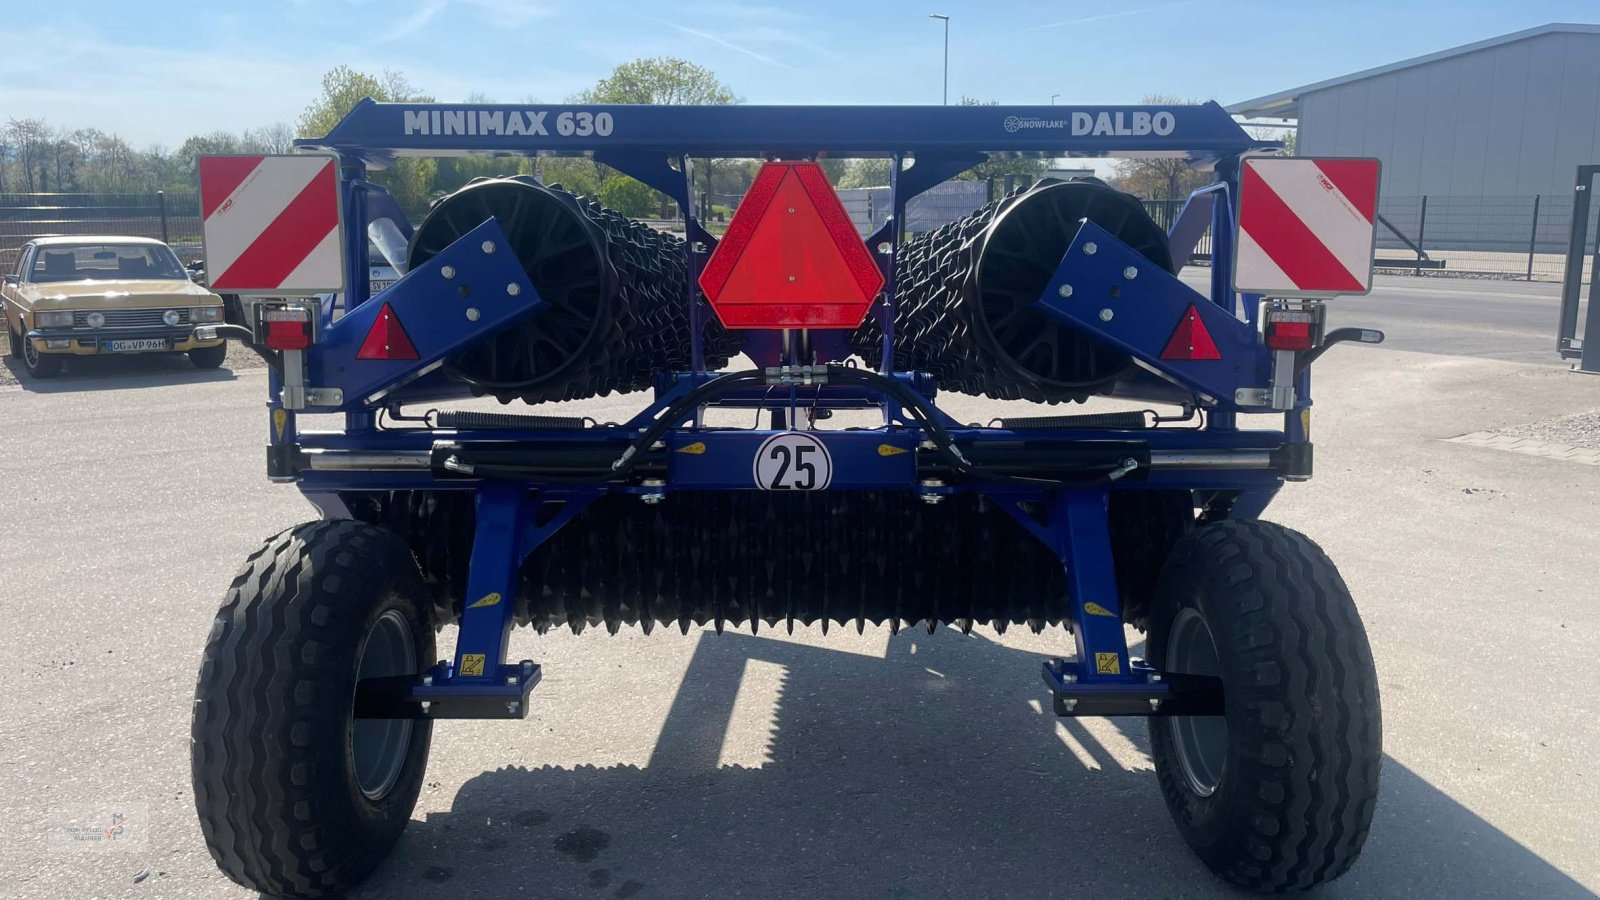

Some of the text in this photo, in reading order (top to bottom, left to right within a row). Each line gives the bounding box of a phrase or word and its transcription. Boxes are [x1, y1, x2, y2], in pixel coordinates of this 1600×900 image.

[404, 110, 614, 137] MINIMAX 630
[1071, 111, 1176, 136] DALBO
[113, 339, 165, 350] OG VP 96H
[770, 444, 816, 490] 25
